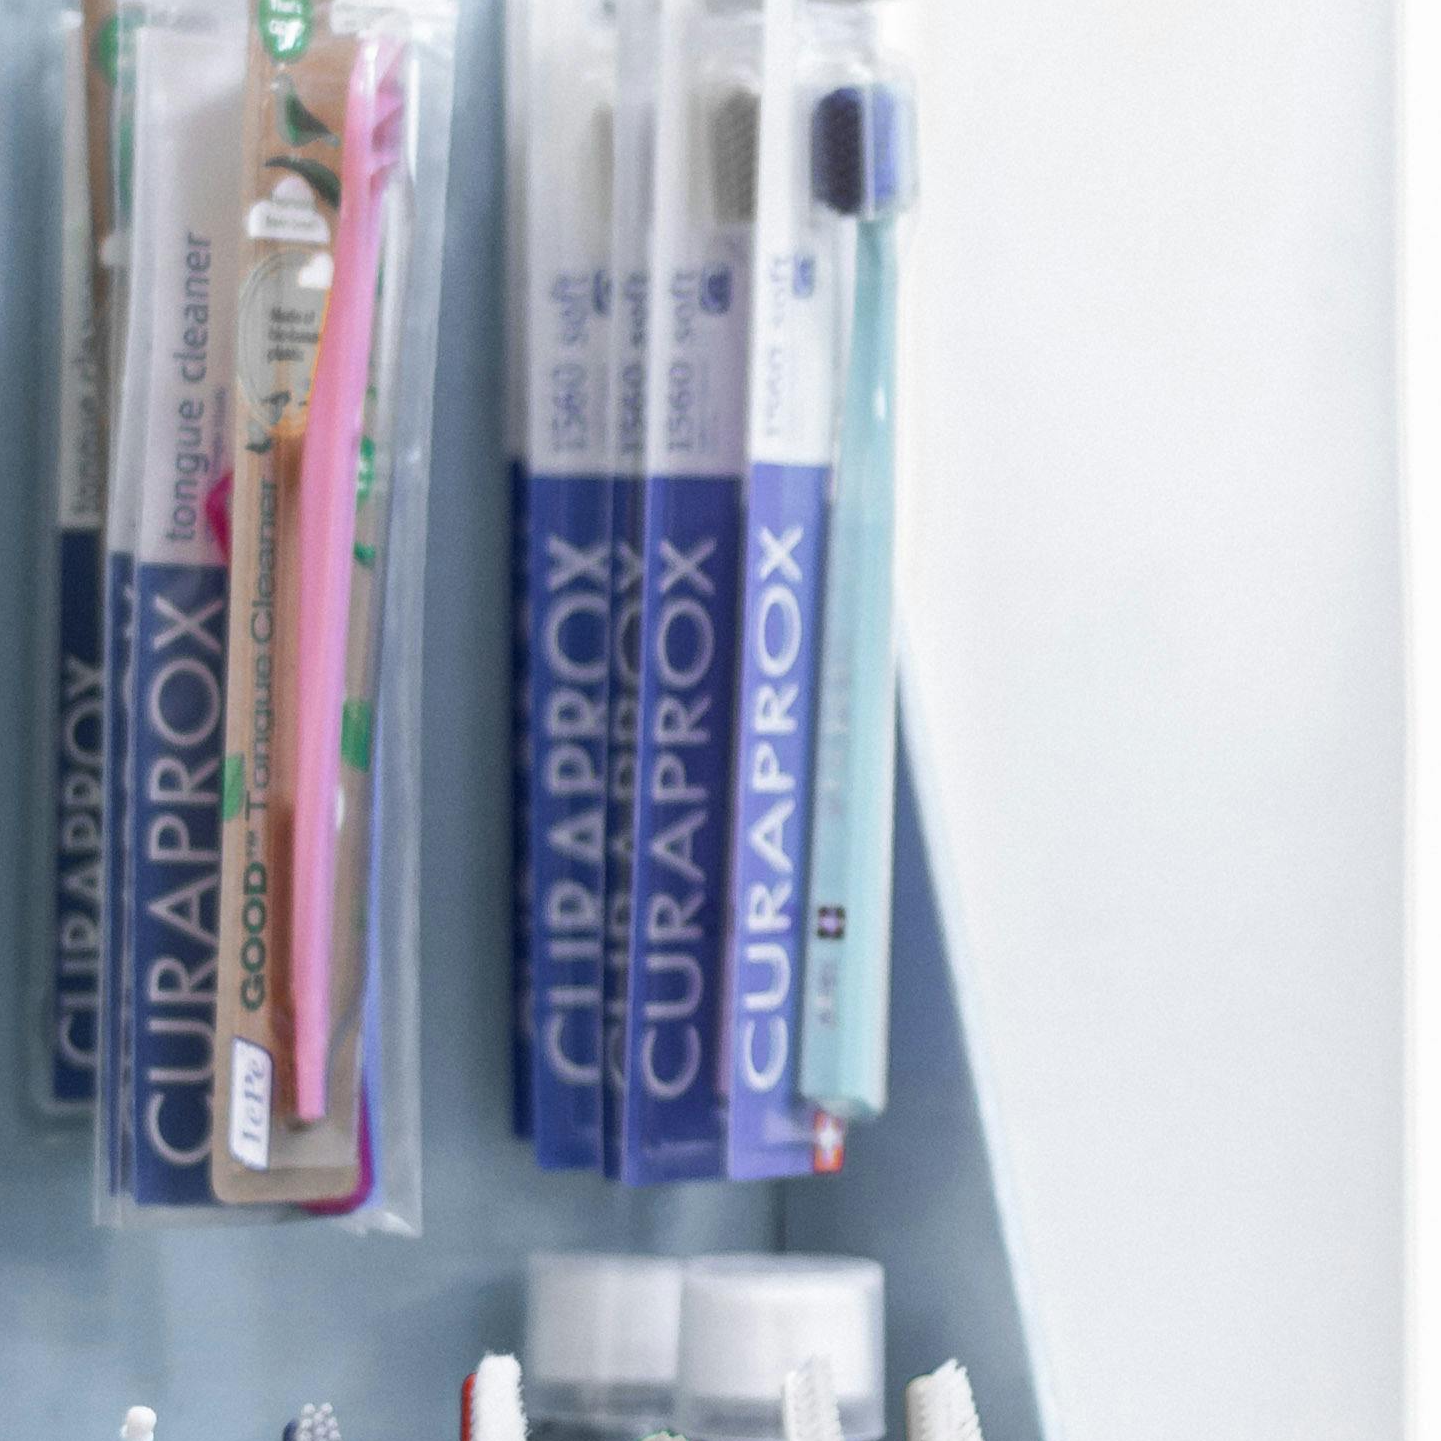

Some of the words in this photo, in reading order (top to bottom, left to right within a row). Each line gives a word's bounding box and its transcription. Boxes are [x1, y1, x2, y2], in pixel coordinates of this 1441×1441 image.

[174, 231, 212, 383] cleaner
[168, 391, 210, 544] tongue
[249, 480, 277, 644] Cleaner
[144, 596, 223, 1165] CURAPROX
[641, 535, 717, 1100] CURAPROX
[744, 525, 804, 1092] CURAPROX
[240, 861, 268, 1010] GOOD
